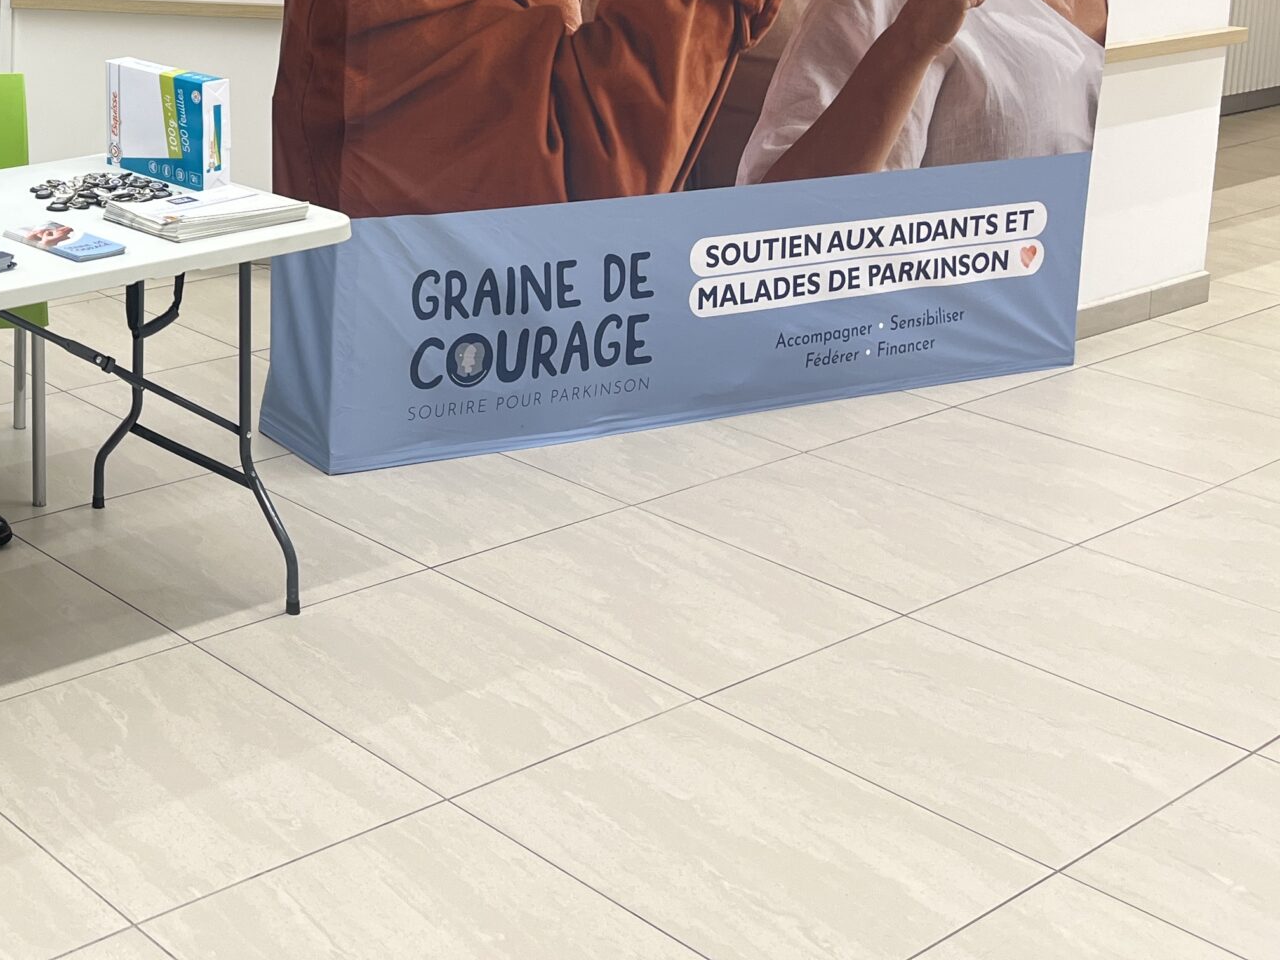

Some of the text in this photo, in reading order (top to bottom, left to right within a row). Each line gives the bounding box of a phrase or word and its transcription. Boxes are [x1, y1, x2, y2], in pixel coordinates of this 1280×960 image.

[111, 90, 119, 137] Esquisse
[163, 95, 178, 152] 100g A4
[176, 88, 191, 153] 500 feuilles
[705, 209, 1035, 268] SOUTIEN AUX AIDANTS ET
[411, 251, 655, 321] GRAINE DE
[697, 250, 1009, 310] MALADES DE PARKINSON
[409, 313, 653, 390] COURAGE
[775, 307, 965, 349] Accompagner Sensibiliser
[805, 337, 936, 368] Fédérer Financer
[407, 376, 651, 421] SOURIRE POUR PARKINSON
